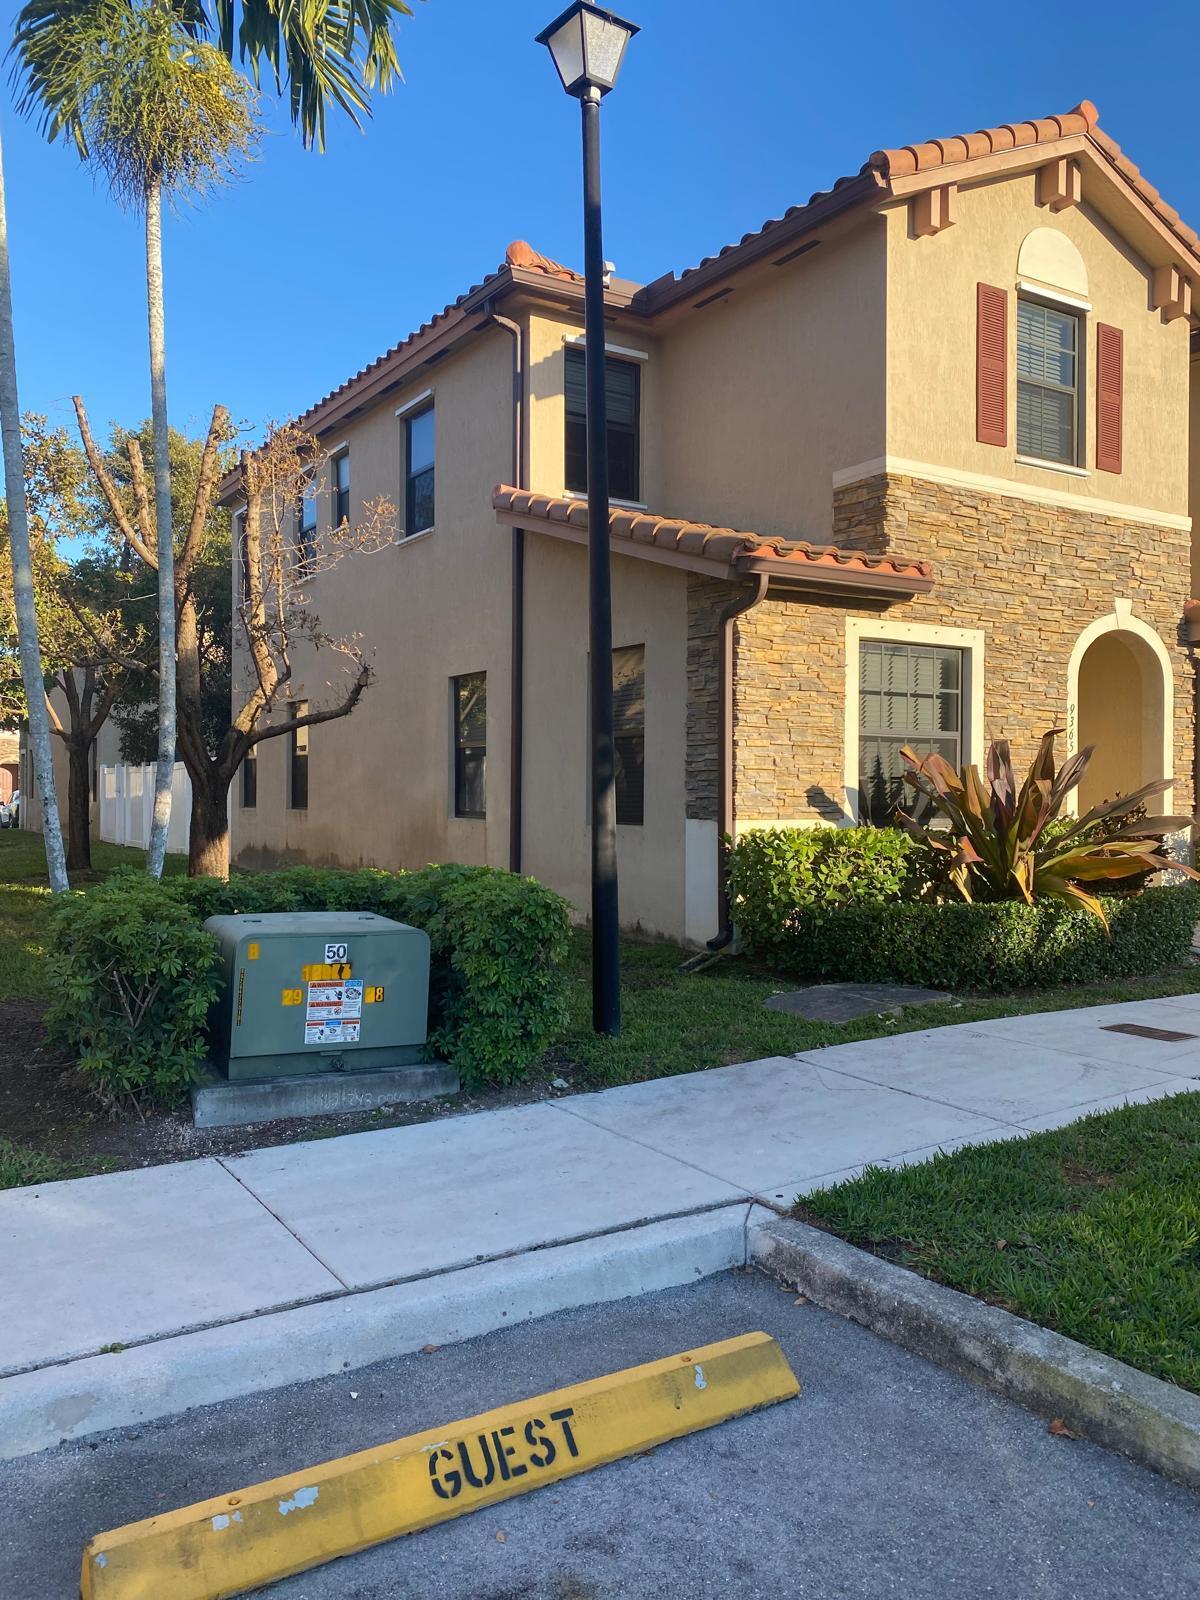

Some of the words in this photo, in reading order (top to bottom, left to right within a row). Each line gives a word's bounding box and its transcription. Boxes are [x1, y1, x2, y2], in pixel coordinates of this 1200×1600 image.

[327, 945, 347, 960] 50
[282, 989, 302, 1006] 29
[429, 1407, 579, 1499] GUEST
